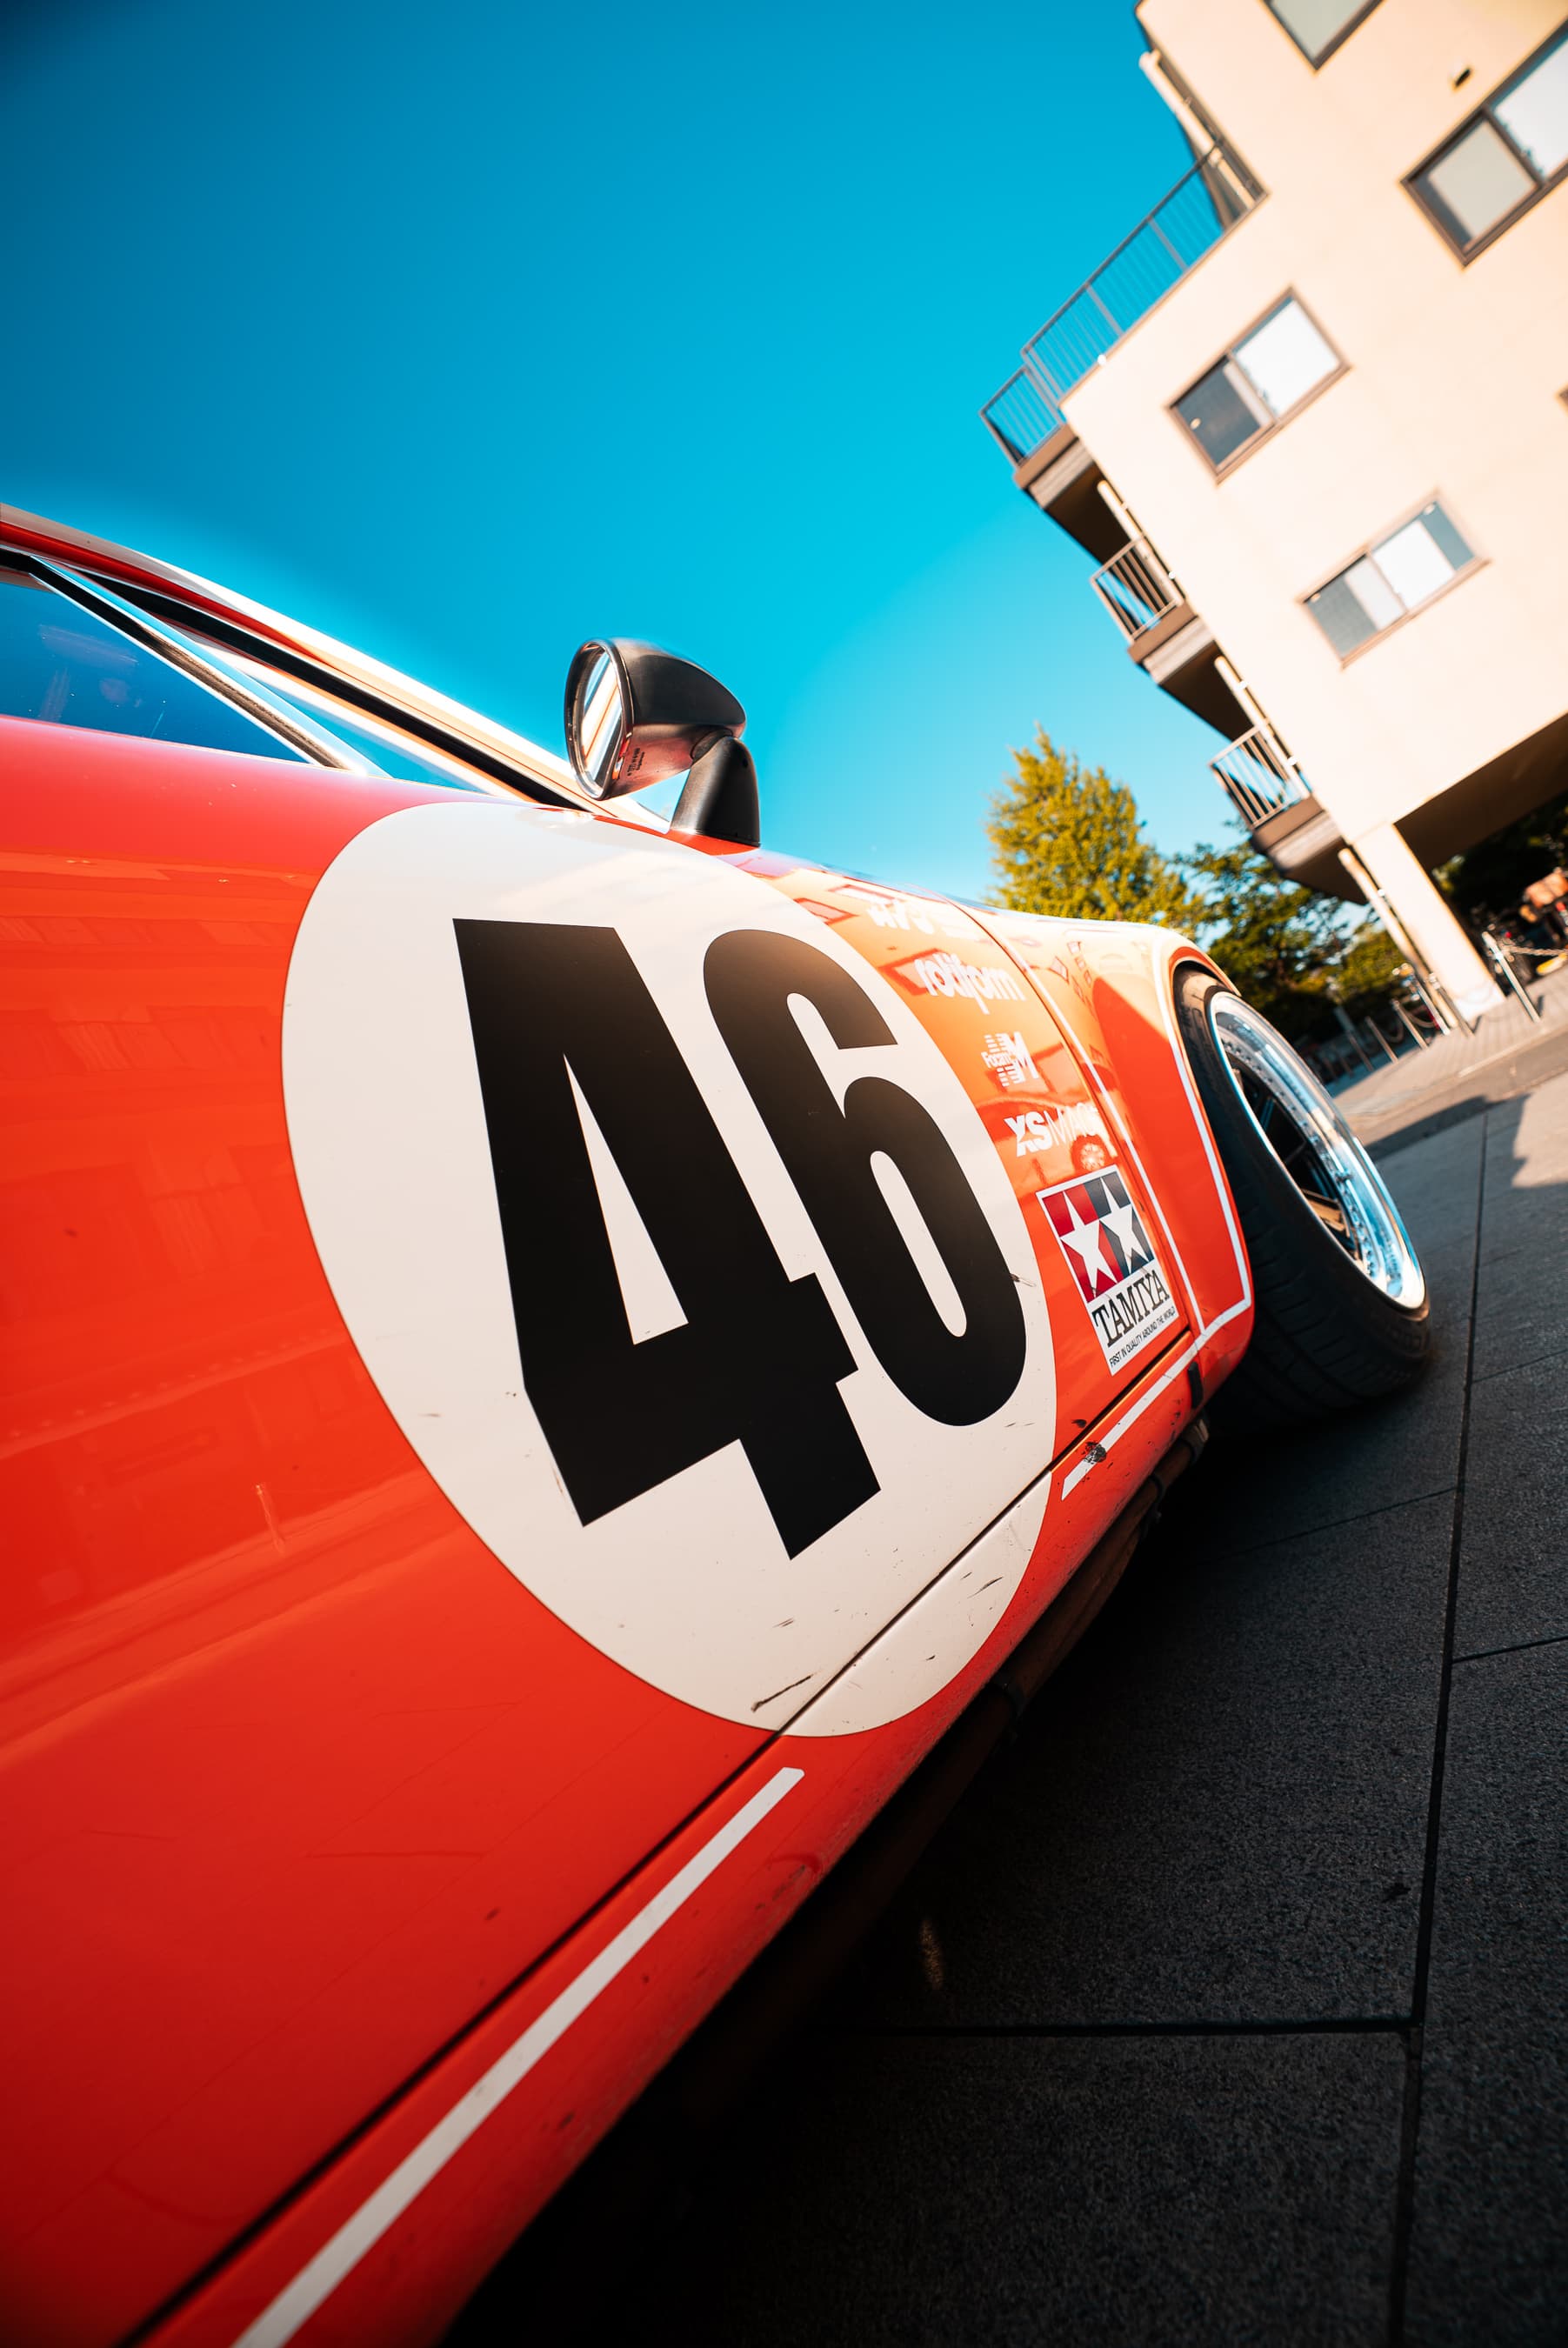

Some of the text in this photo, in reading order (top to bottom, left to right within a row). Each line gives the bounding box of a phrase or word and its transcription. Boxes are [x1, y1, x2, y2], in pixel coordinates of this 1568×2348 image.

[452, 917, 1026, 1560] 46
[1091, 1270, 1170, 1347] TAMIYA
[1109, 1351, 1122, 1367] FIRST
[1125, 1332, 1143, 1353] QUALITY
[1142, 1321, 1158, 1338] AROUND
